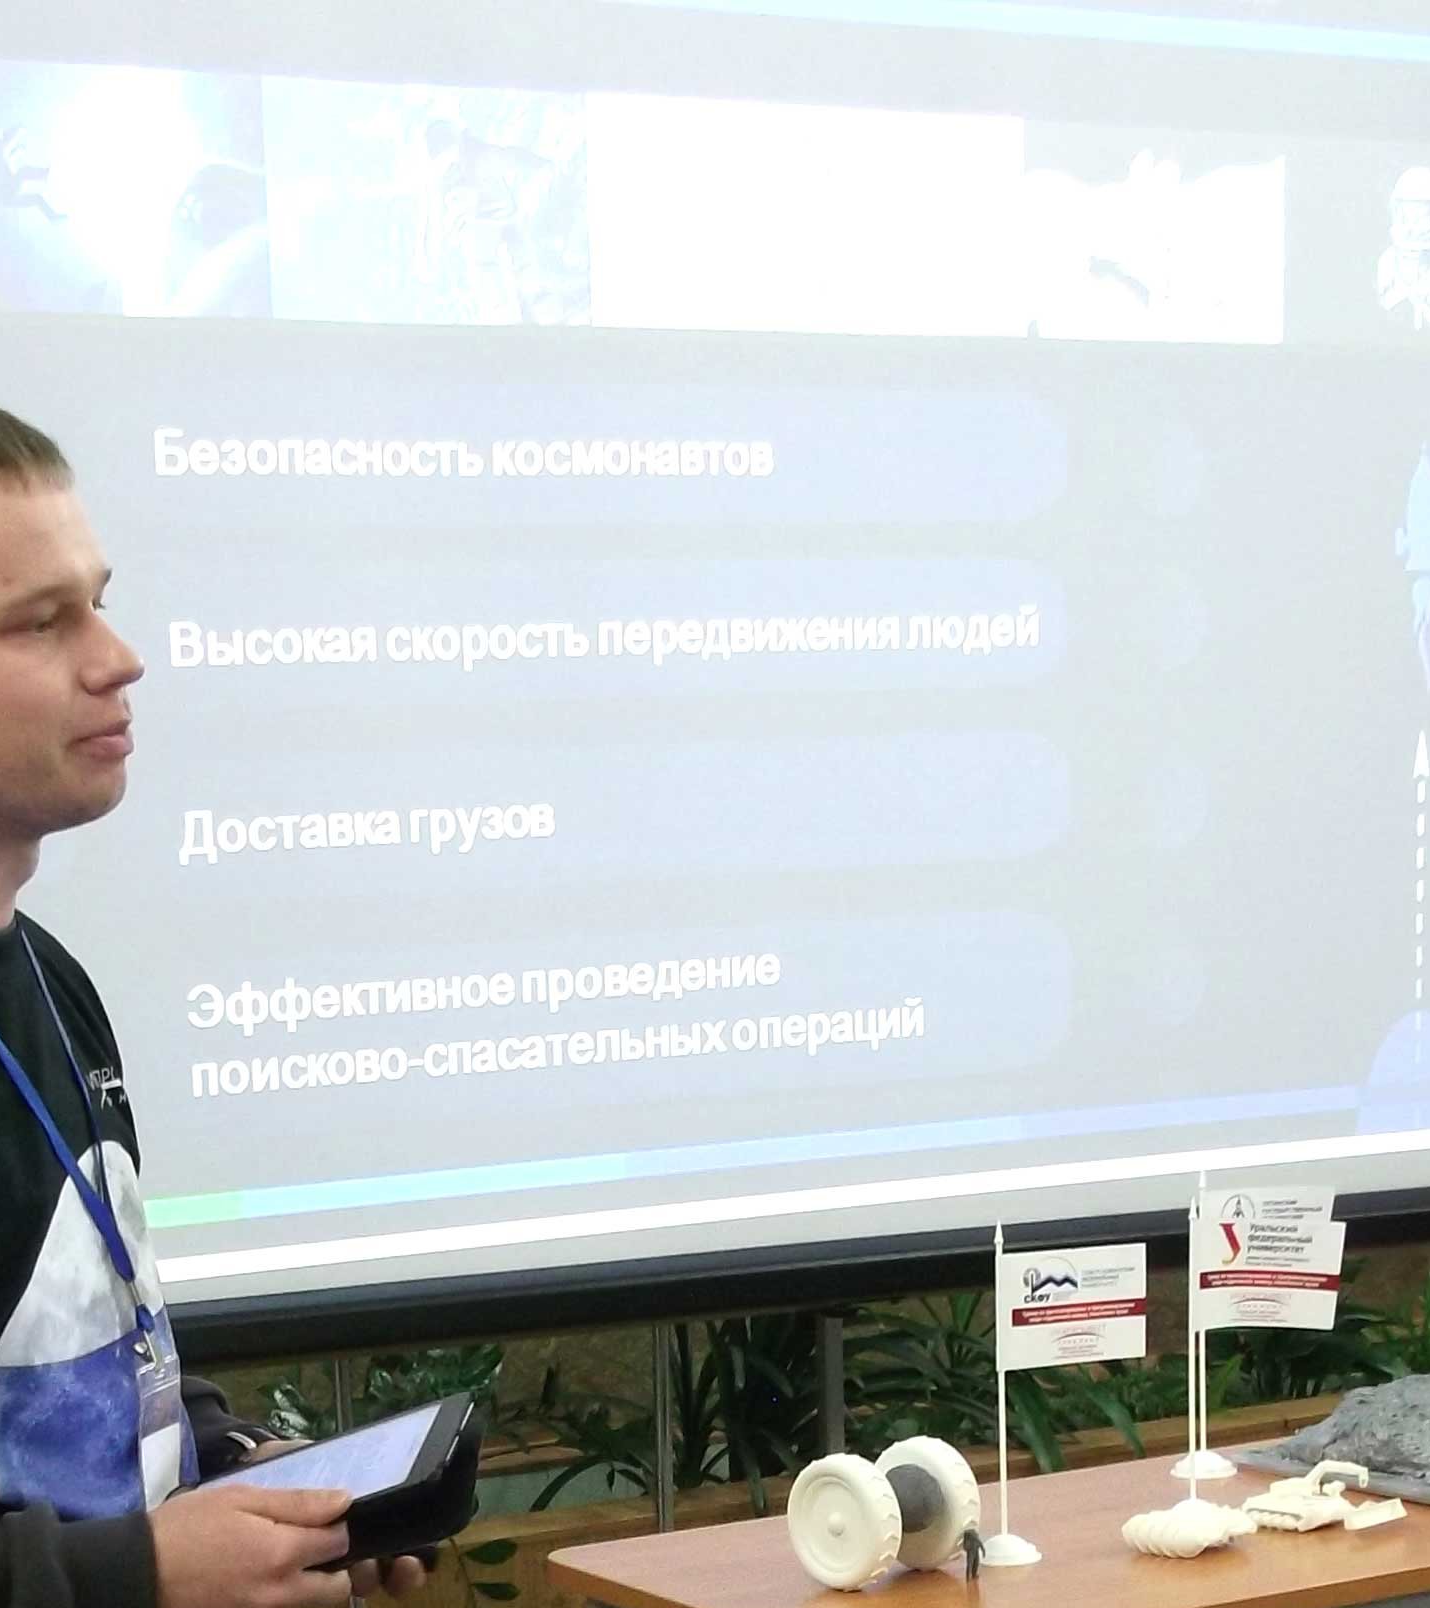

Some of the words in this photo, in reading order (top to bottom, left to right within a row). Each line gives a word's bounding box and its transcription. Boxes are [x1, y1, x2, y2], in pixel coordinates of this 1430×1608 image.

[152, 426, 483, 480] Безопасность
[491, 433, 775, 480] космонавтов
[170, 617, 377, 669] Высокая
[384, 617, 589, 672] скорость
[597, 608, 902, 666] передвижения
[907, 601, 1041, 656] людей
[179, 806, 402, 867] Доставка
[409, 801, 556, 855] грузов
[186, 969, 515, 1036] Эффективное
[521, 948, 783, 1012] проведение
[191, 1016, 728, 1099] поисково-спасательных
[732, 996, 926, 1055] операций
